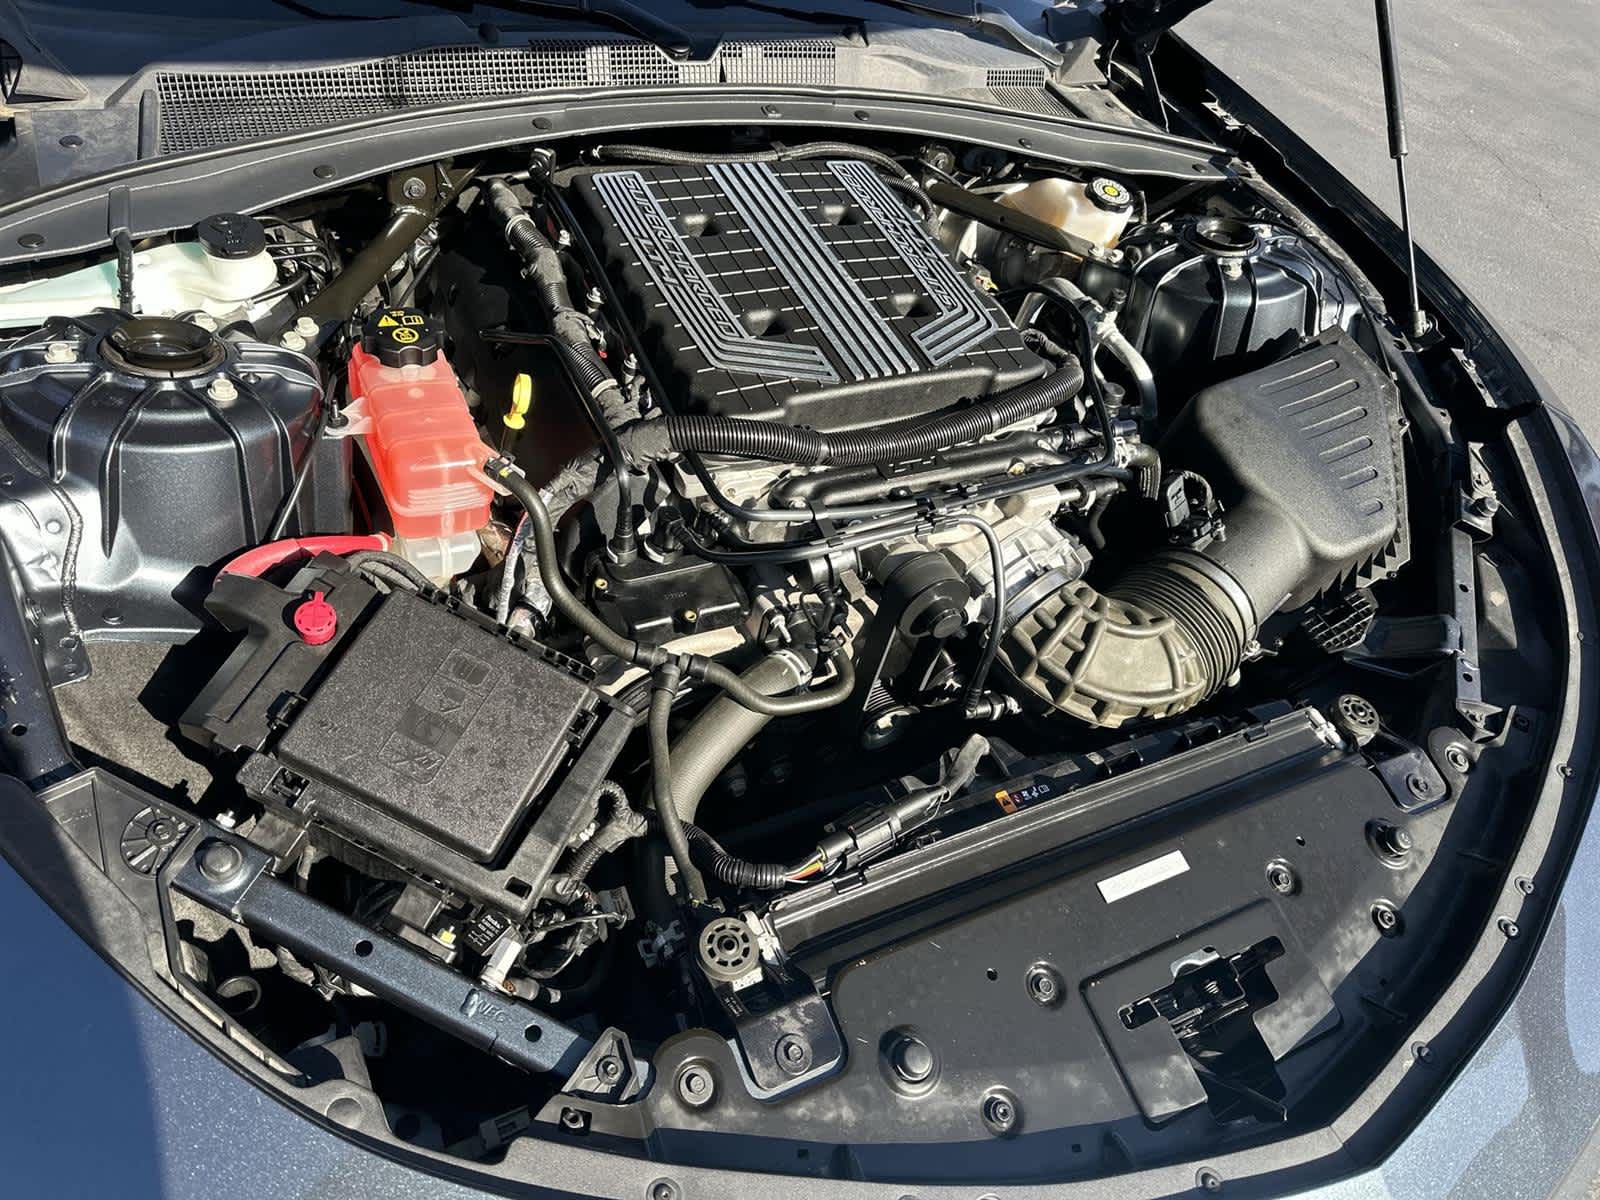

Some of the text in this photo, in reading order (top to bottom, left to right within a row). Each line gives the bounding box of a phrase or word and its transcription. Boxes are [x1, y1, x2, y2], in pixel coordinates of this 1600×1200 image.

[622, 174, 738, 337] SUPERCHARGED
[639, 233, 679, 289] LT4
[836, 164, 957, 308] SUPERCHARGED
[896, 216, 939, 263] LT4
